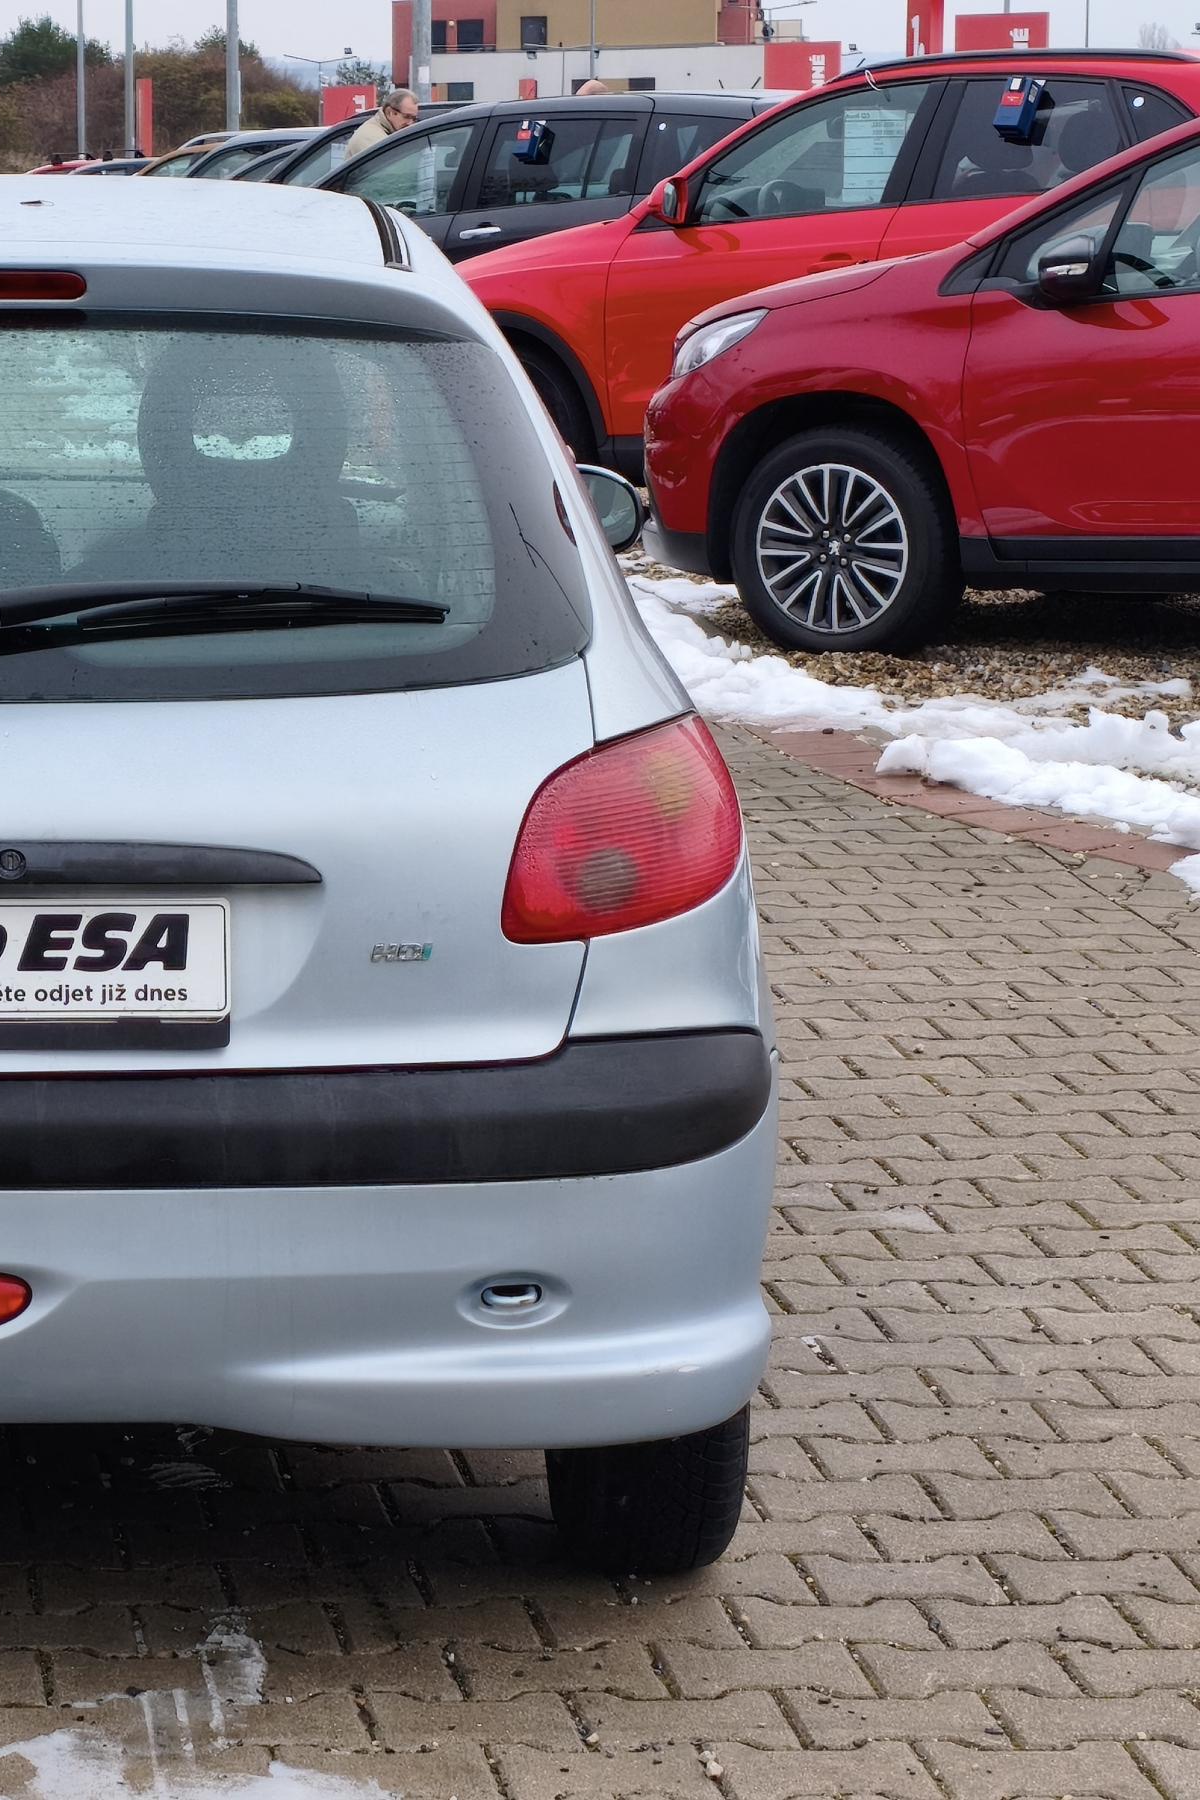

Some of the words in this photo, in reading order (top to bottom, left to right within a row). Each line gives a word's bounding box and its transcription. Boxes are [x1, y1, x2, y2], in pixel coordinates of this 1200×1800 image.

[17, 912, 190, 972] ESA
[34, 984, 93, 1005] odjet
[100, 984, 127, 1005] již
[134, 984, 188, 1001] dnes
